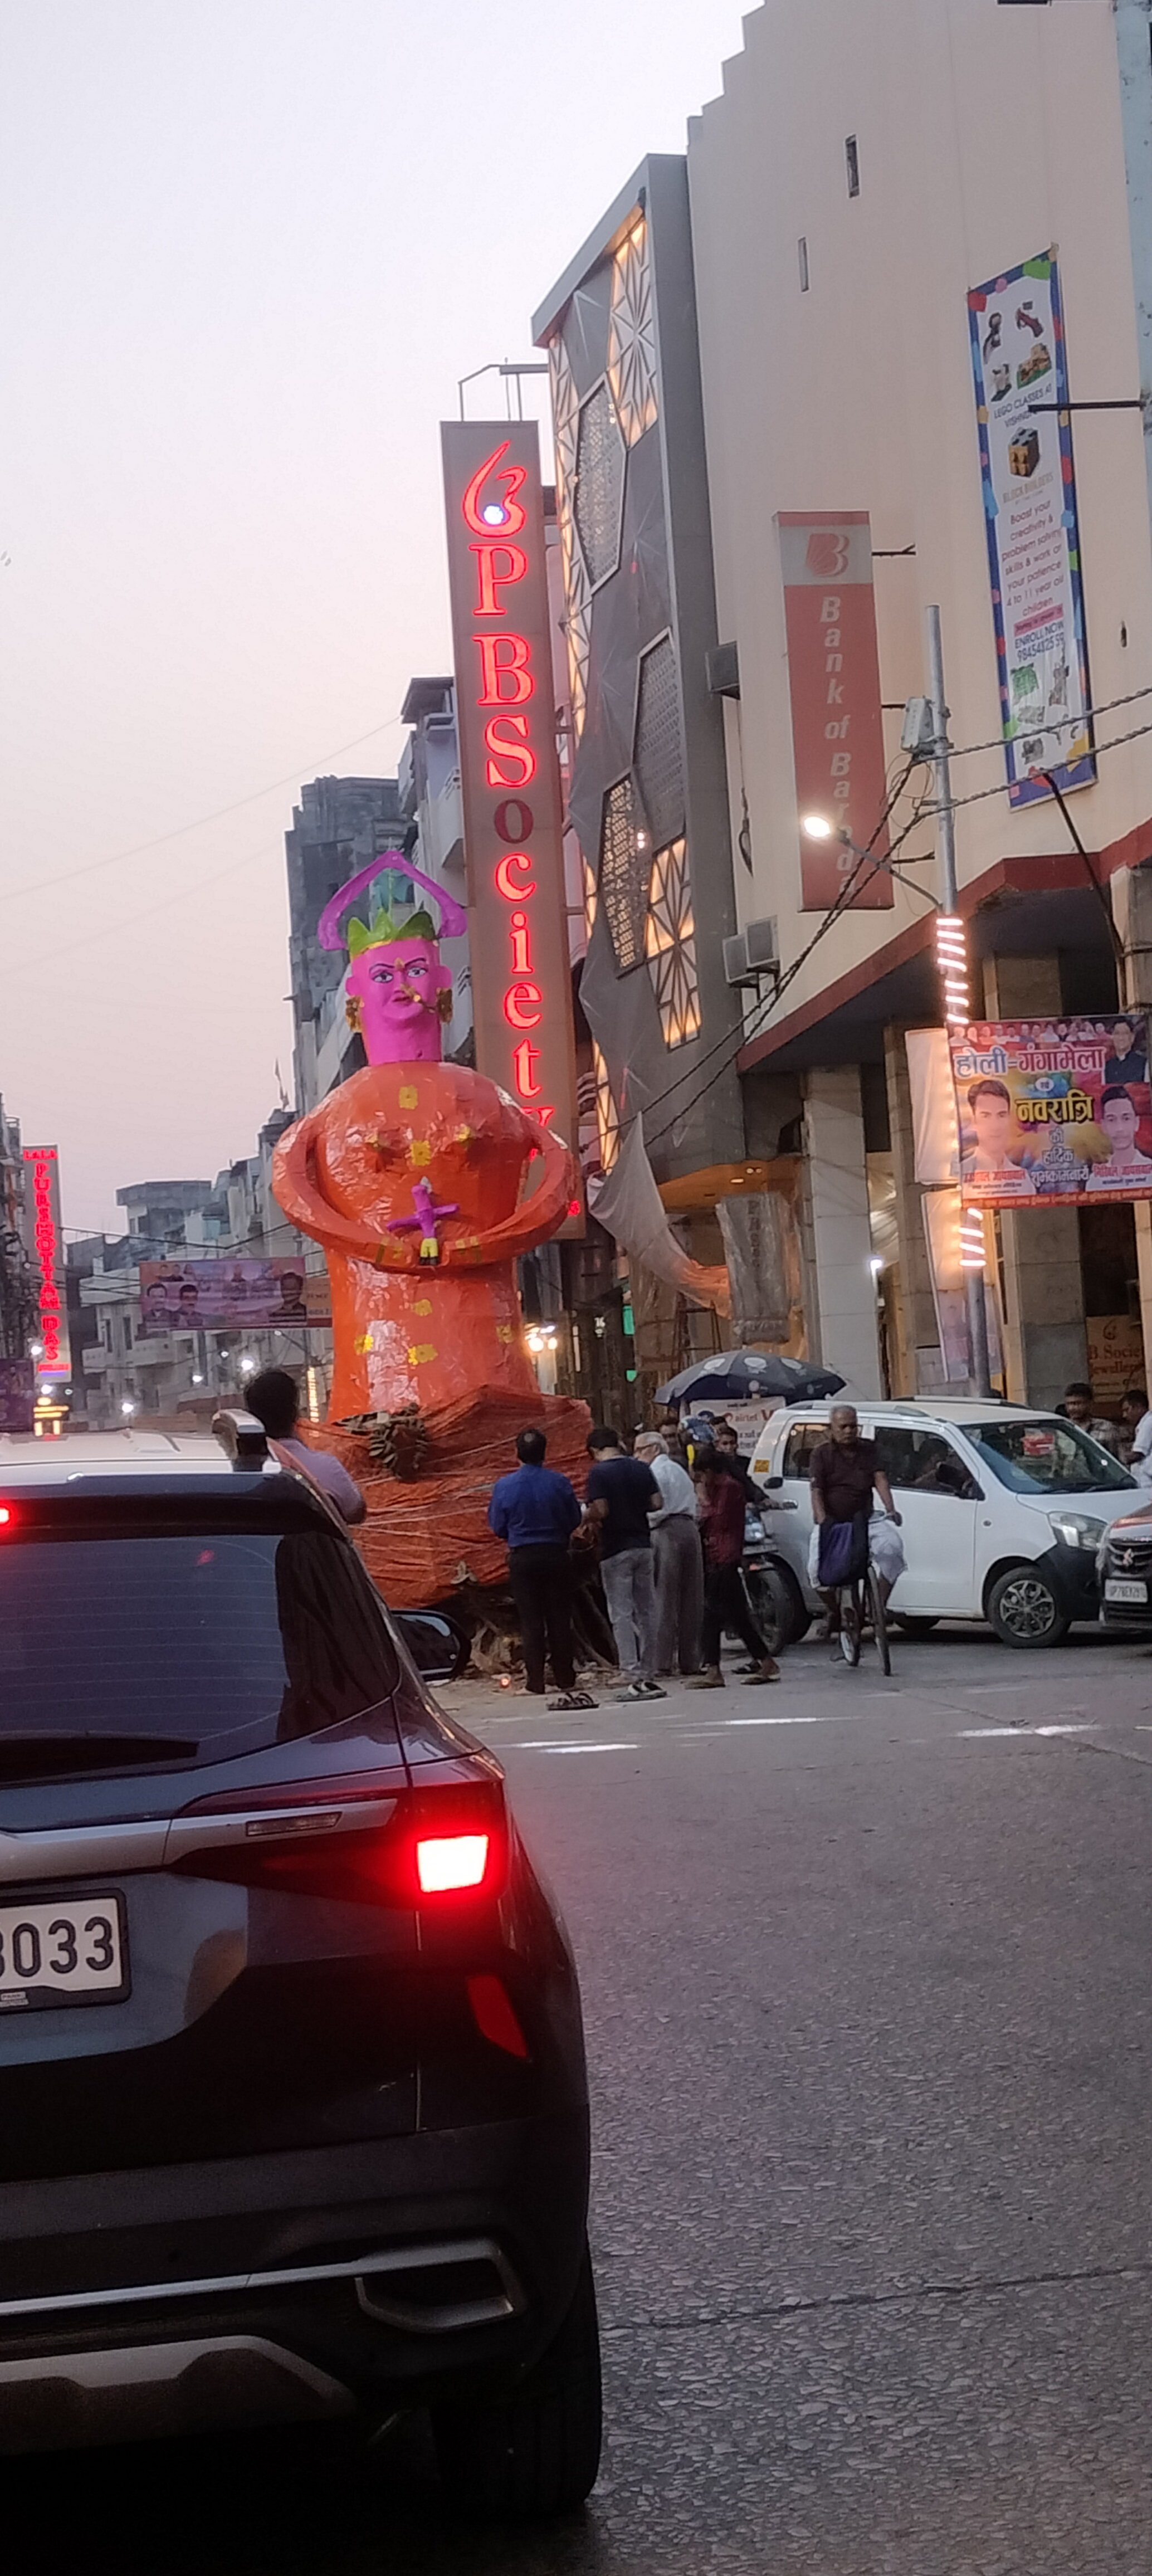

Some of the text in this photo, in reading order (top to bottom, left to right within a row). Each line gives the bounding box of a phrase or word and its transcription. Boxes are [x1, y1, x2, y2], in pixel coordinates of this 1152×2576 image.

[1002, 540, 1036, 563] problem
[1027, 561, 1061, 583] patience
[820, 596, 845, 704] Bank
[824, 714, 851, 739] of
[1015, 1089, 1094, 1124] नवरात्रि
[41, 1315, 60, 1360] DAS
[735, 1409, 759, 1422] airtel
[0, 1916, 114, 1978] 033
